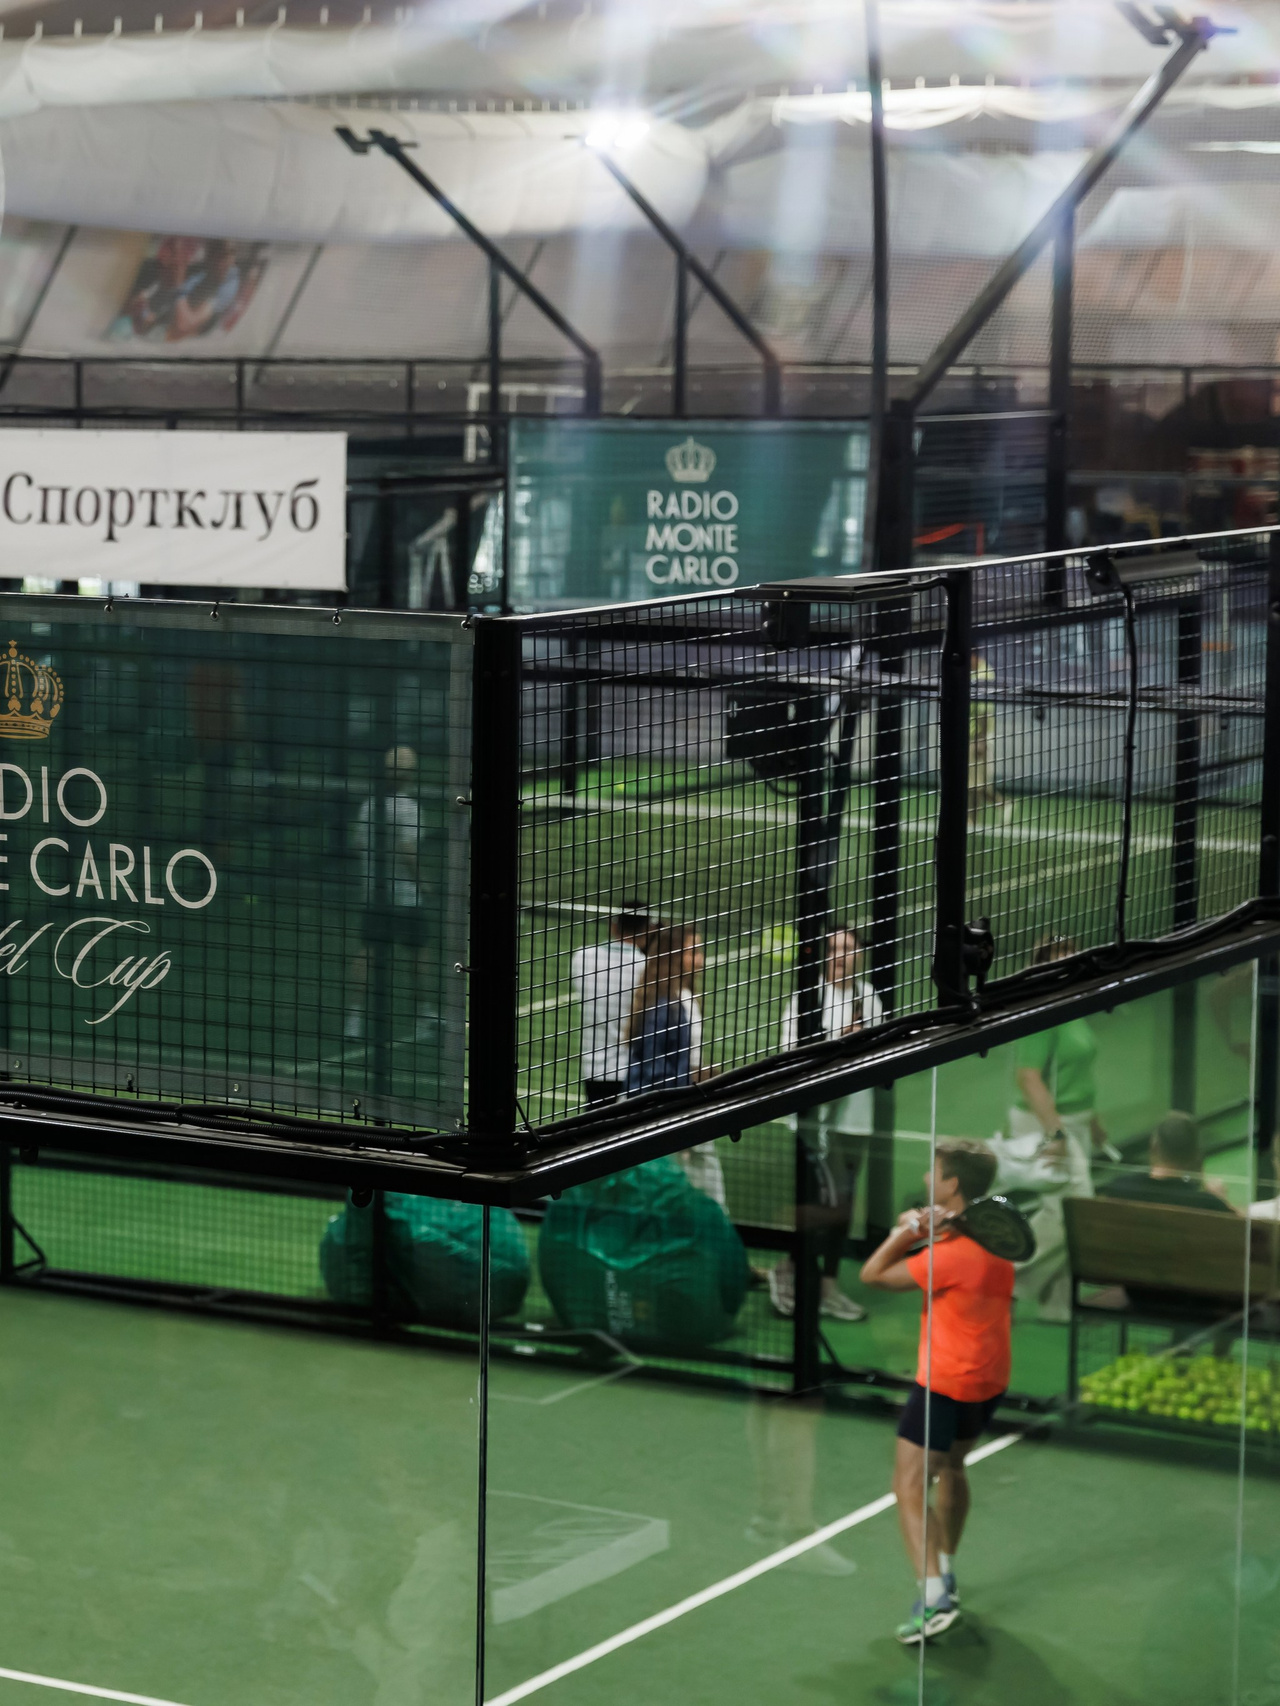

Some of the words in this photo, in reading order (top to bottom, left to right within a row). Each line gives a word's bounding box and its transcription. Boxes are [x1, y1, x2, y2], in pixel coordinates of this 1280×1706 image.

[2, 471, 321, 542] Спортклуб
[646, 489, 739, 521] RADIO
[645, 522, 739, 554] MONTE
[645, 554, 739, 586] CARLO
[30, 837, 217, 909] CARLO
[54, 917, 173, 1025] Cup
